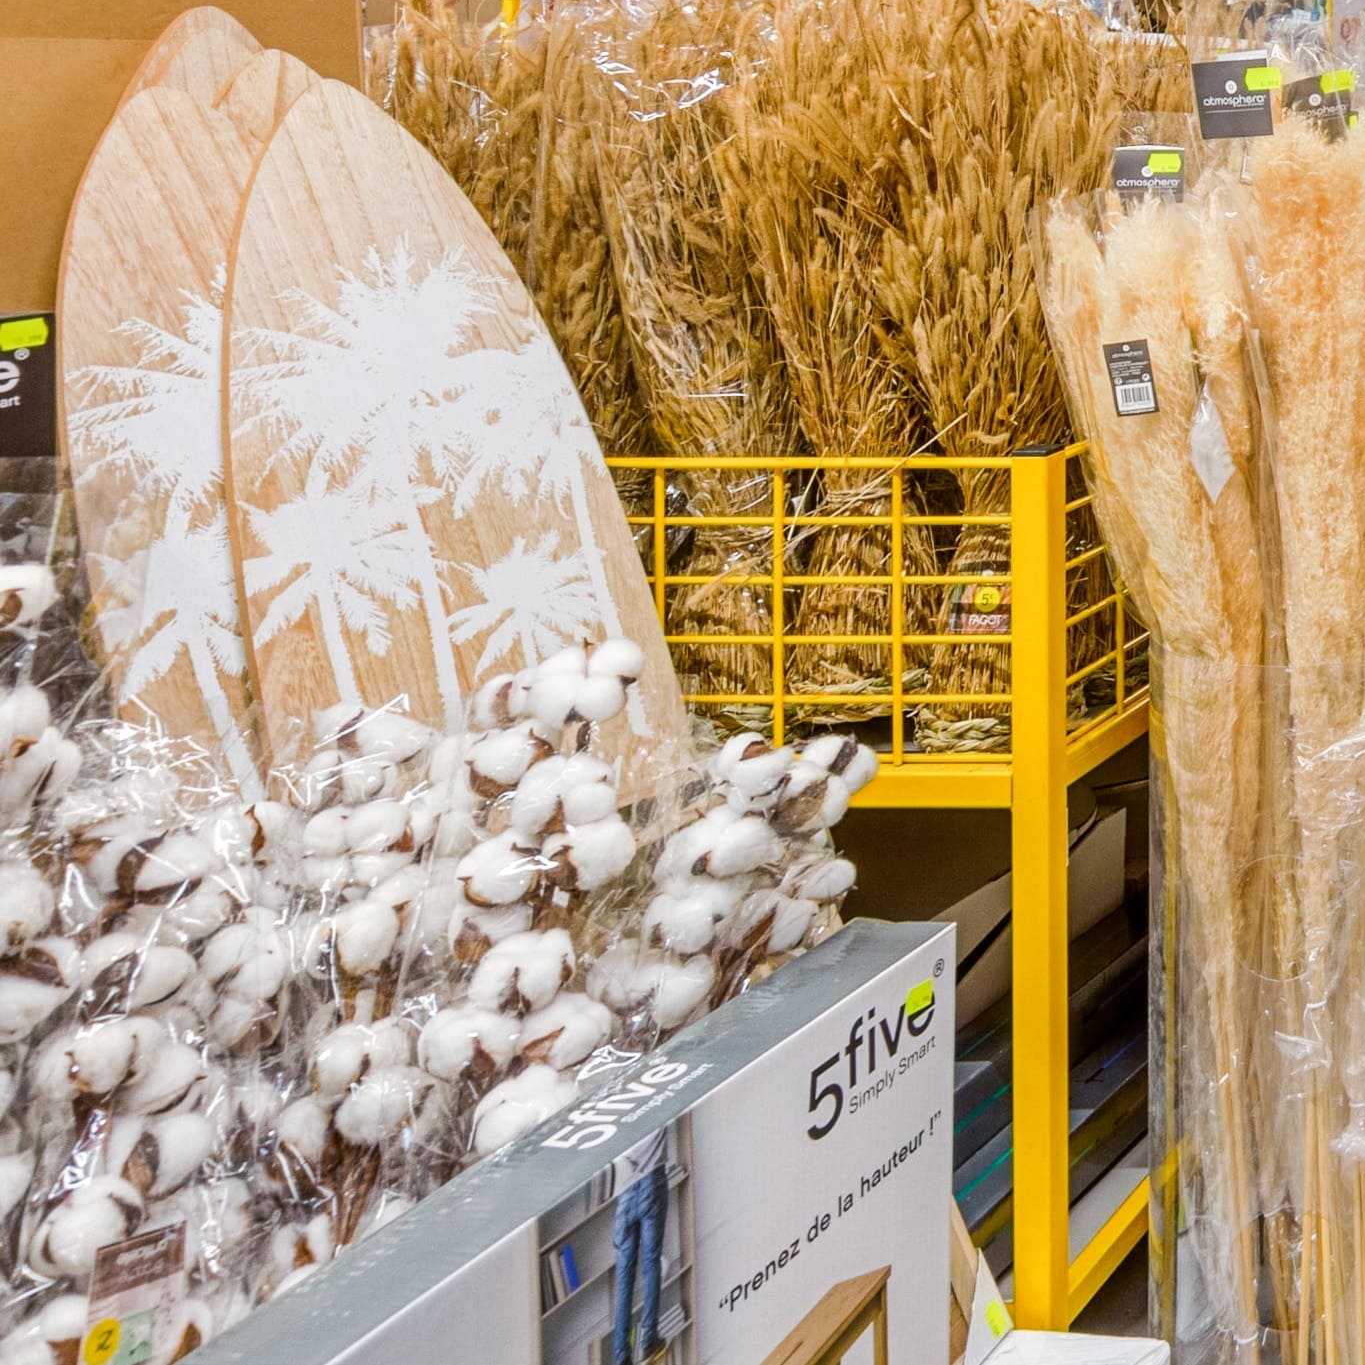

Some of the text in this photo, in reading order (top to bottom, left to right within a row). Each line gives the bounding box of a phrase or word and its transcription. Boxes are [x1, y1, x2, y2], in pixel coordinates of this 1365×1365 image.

[1203, 94, 1266, 107] atmosphera
[1116, 178, 1180, 189] atmosphera
[969, 614, 1002, 625] FAGOT
[849, 1036, 936, 1114] Simply Smart
[540, 1062, 688, 1150] 5five
[807, 1214, 831, 1244] de
[838, 1193, 853, 1218] la
[860, 1129, 925, 1197] hauteur
